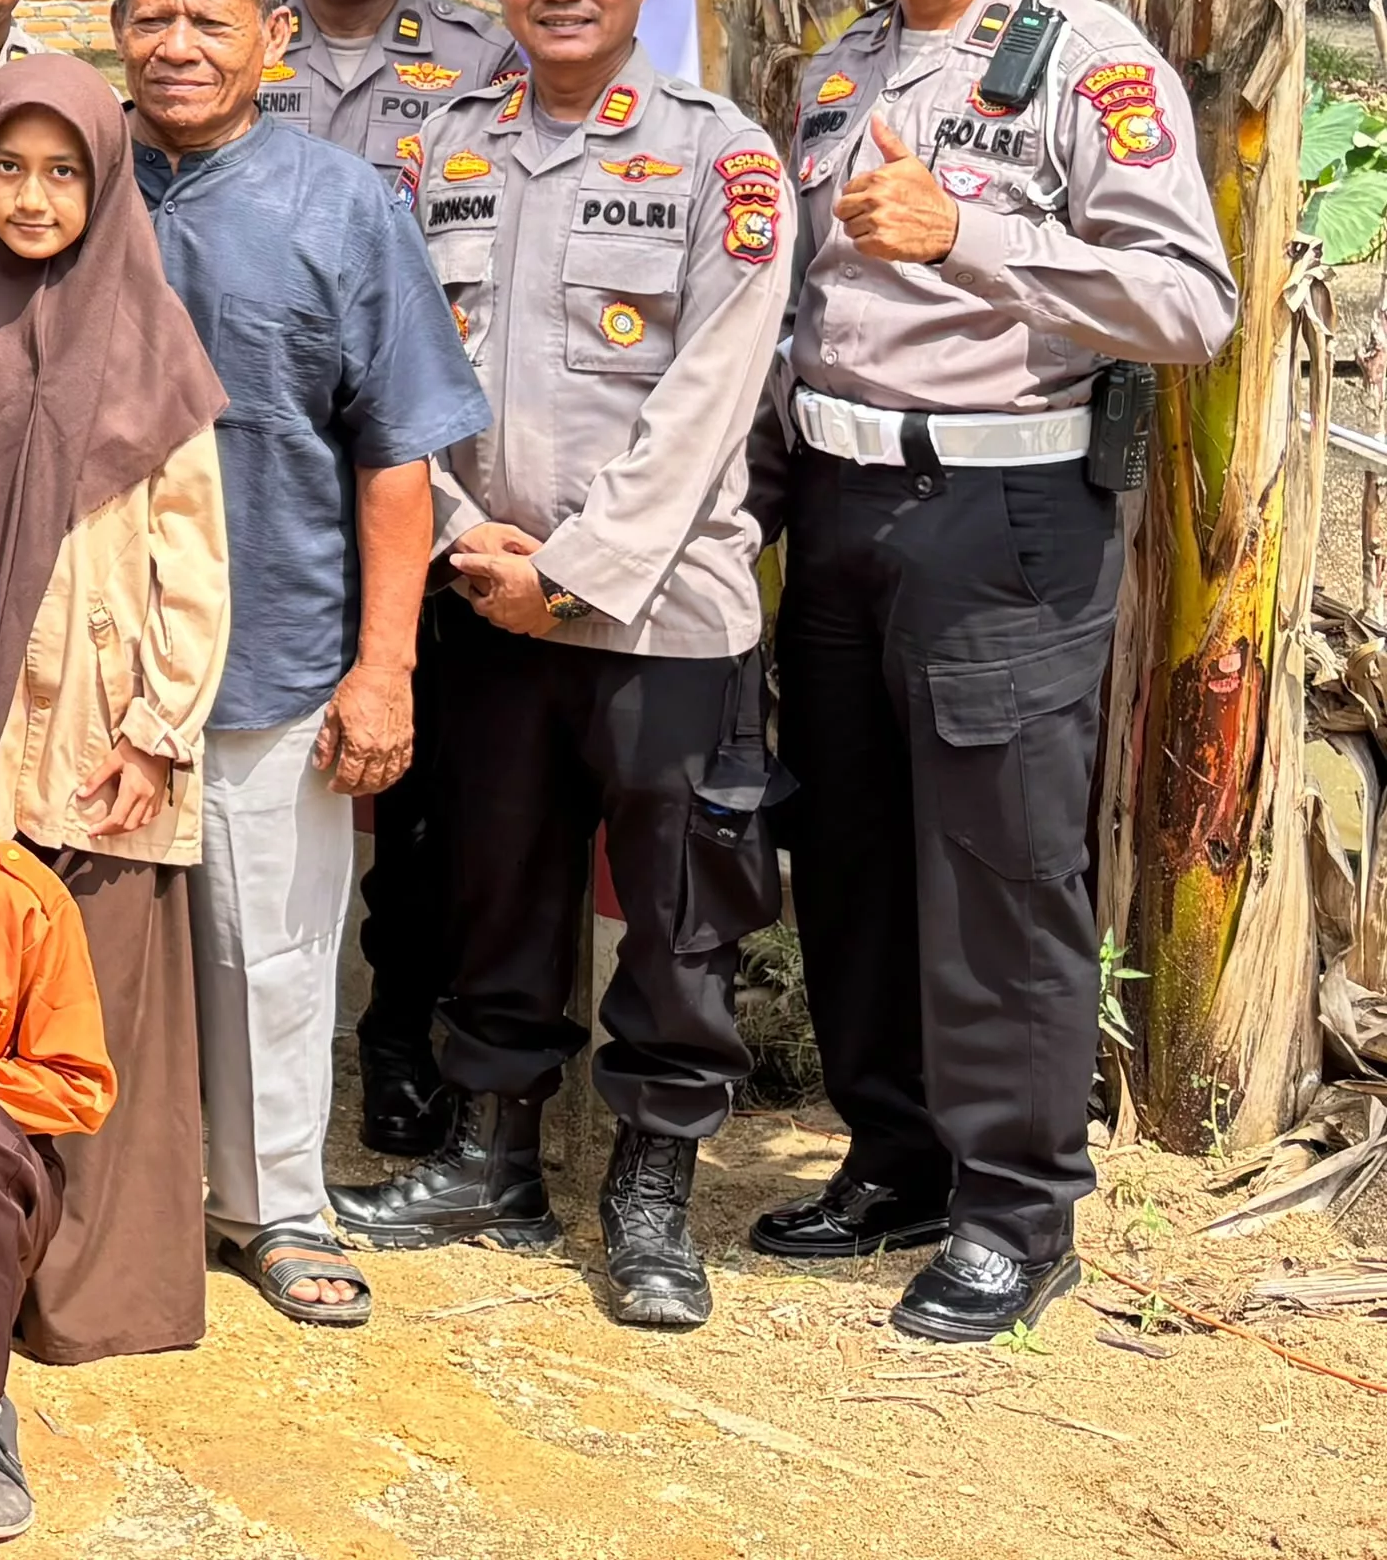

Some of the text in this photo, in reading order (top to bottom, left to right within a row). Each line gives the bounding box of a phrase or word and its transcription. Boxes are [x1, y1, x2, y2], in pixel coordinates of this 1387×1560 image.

[1100, 86, 1149, 105] RIAU
[934, 116, 1028, 158] POLRI
[730, 183, 776, 197] RIAU
[583, 199, 677, 230] POLRI
